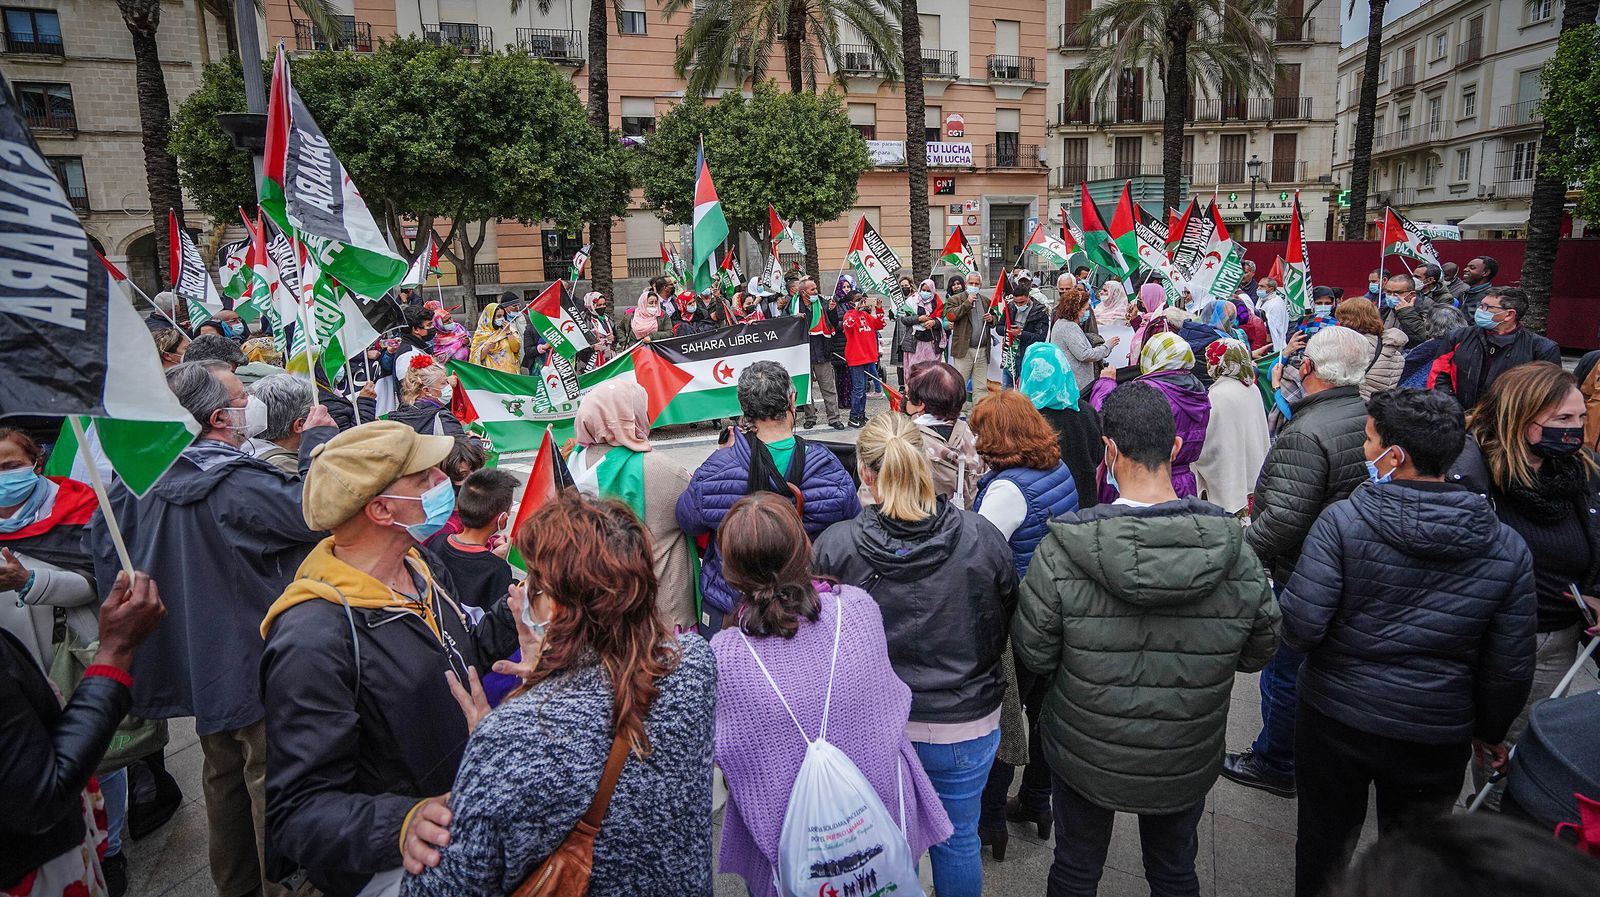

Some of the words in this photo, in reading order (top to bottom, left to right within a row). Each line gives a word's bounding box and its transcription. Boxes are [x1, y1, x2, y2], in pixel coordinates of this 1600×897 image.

[927, 145, 939, 153] TU
[941, 145, 971, 154] LUCHA
[1149, 219, 1169, 240] SAHAR
[863, 229, 888, 258] SAHARA
[880, 250, 900, 274] LIBRE
[1394, 241, 1410, 255] PAZ
[568, 306, 590, 334] SAHARA
[542, 326, 566, 348] LIBRE
[681, 339, 727, 354] SAHARA
[728, 332, 763, 347] LIBRE,
[763, 330, 779, 341] YA
[563, 374, 580, 399] LIBRE
